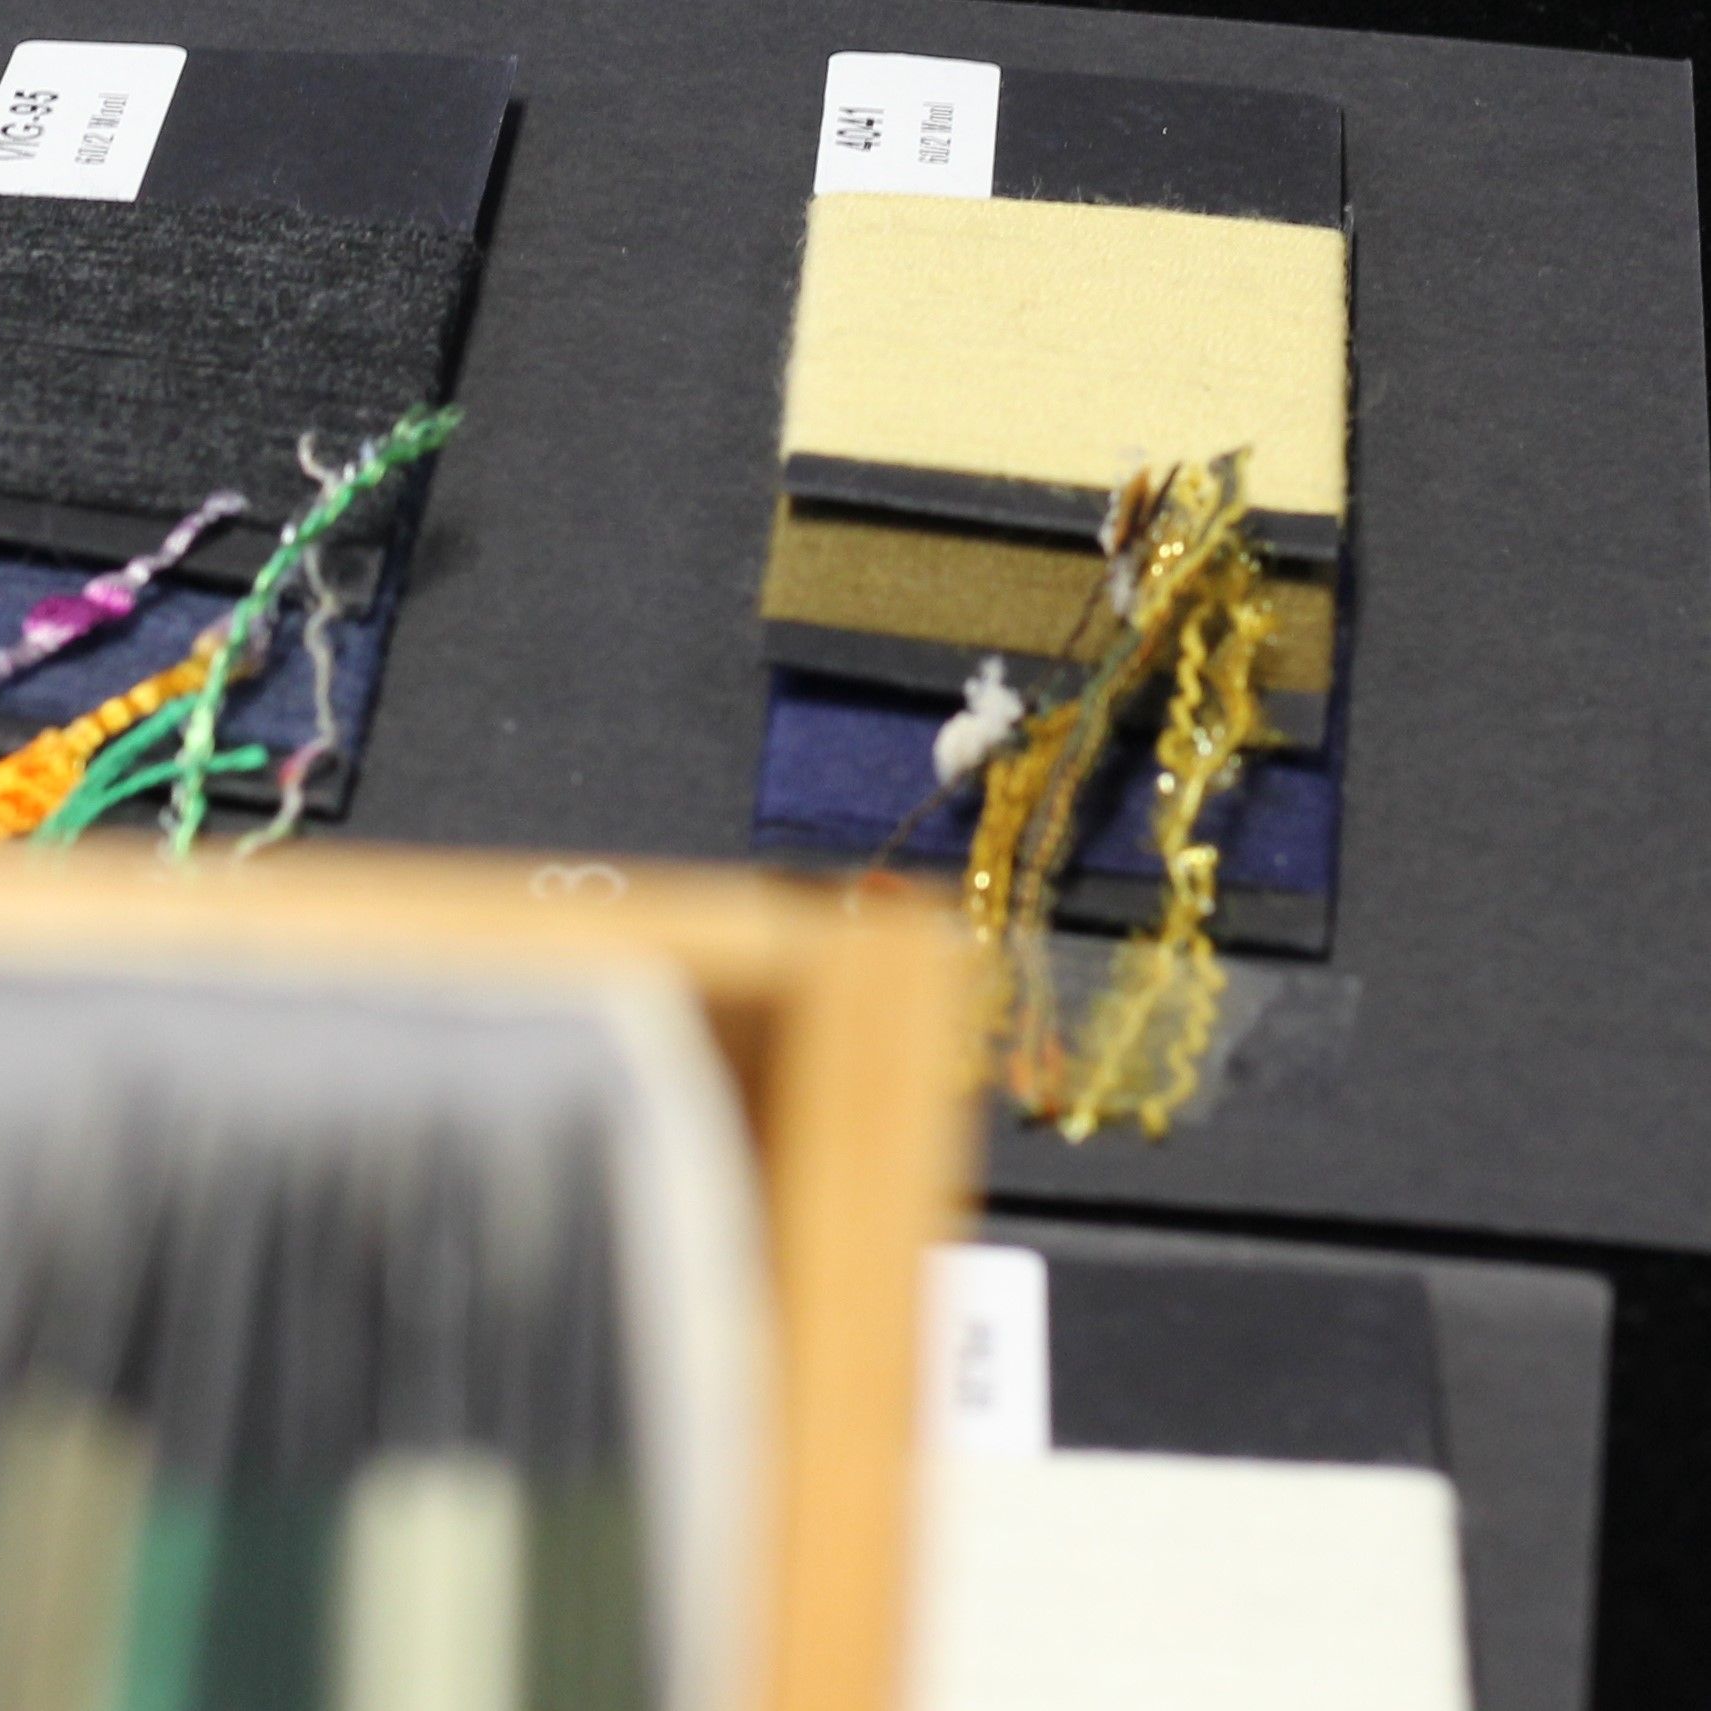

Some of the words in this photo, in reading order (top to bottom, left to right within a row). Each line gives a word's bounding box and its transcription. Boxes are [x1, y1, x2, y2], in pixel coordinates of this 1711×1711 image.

[87, 91, 130, 130] Wool
[835, 106, 885, 153] 4041
[920, 100, 956, 134] Wool
